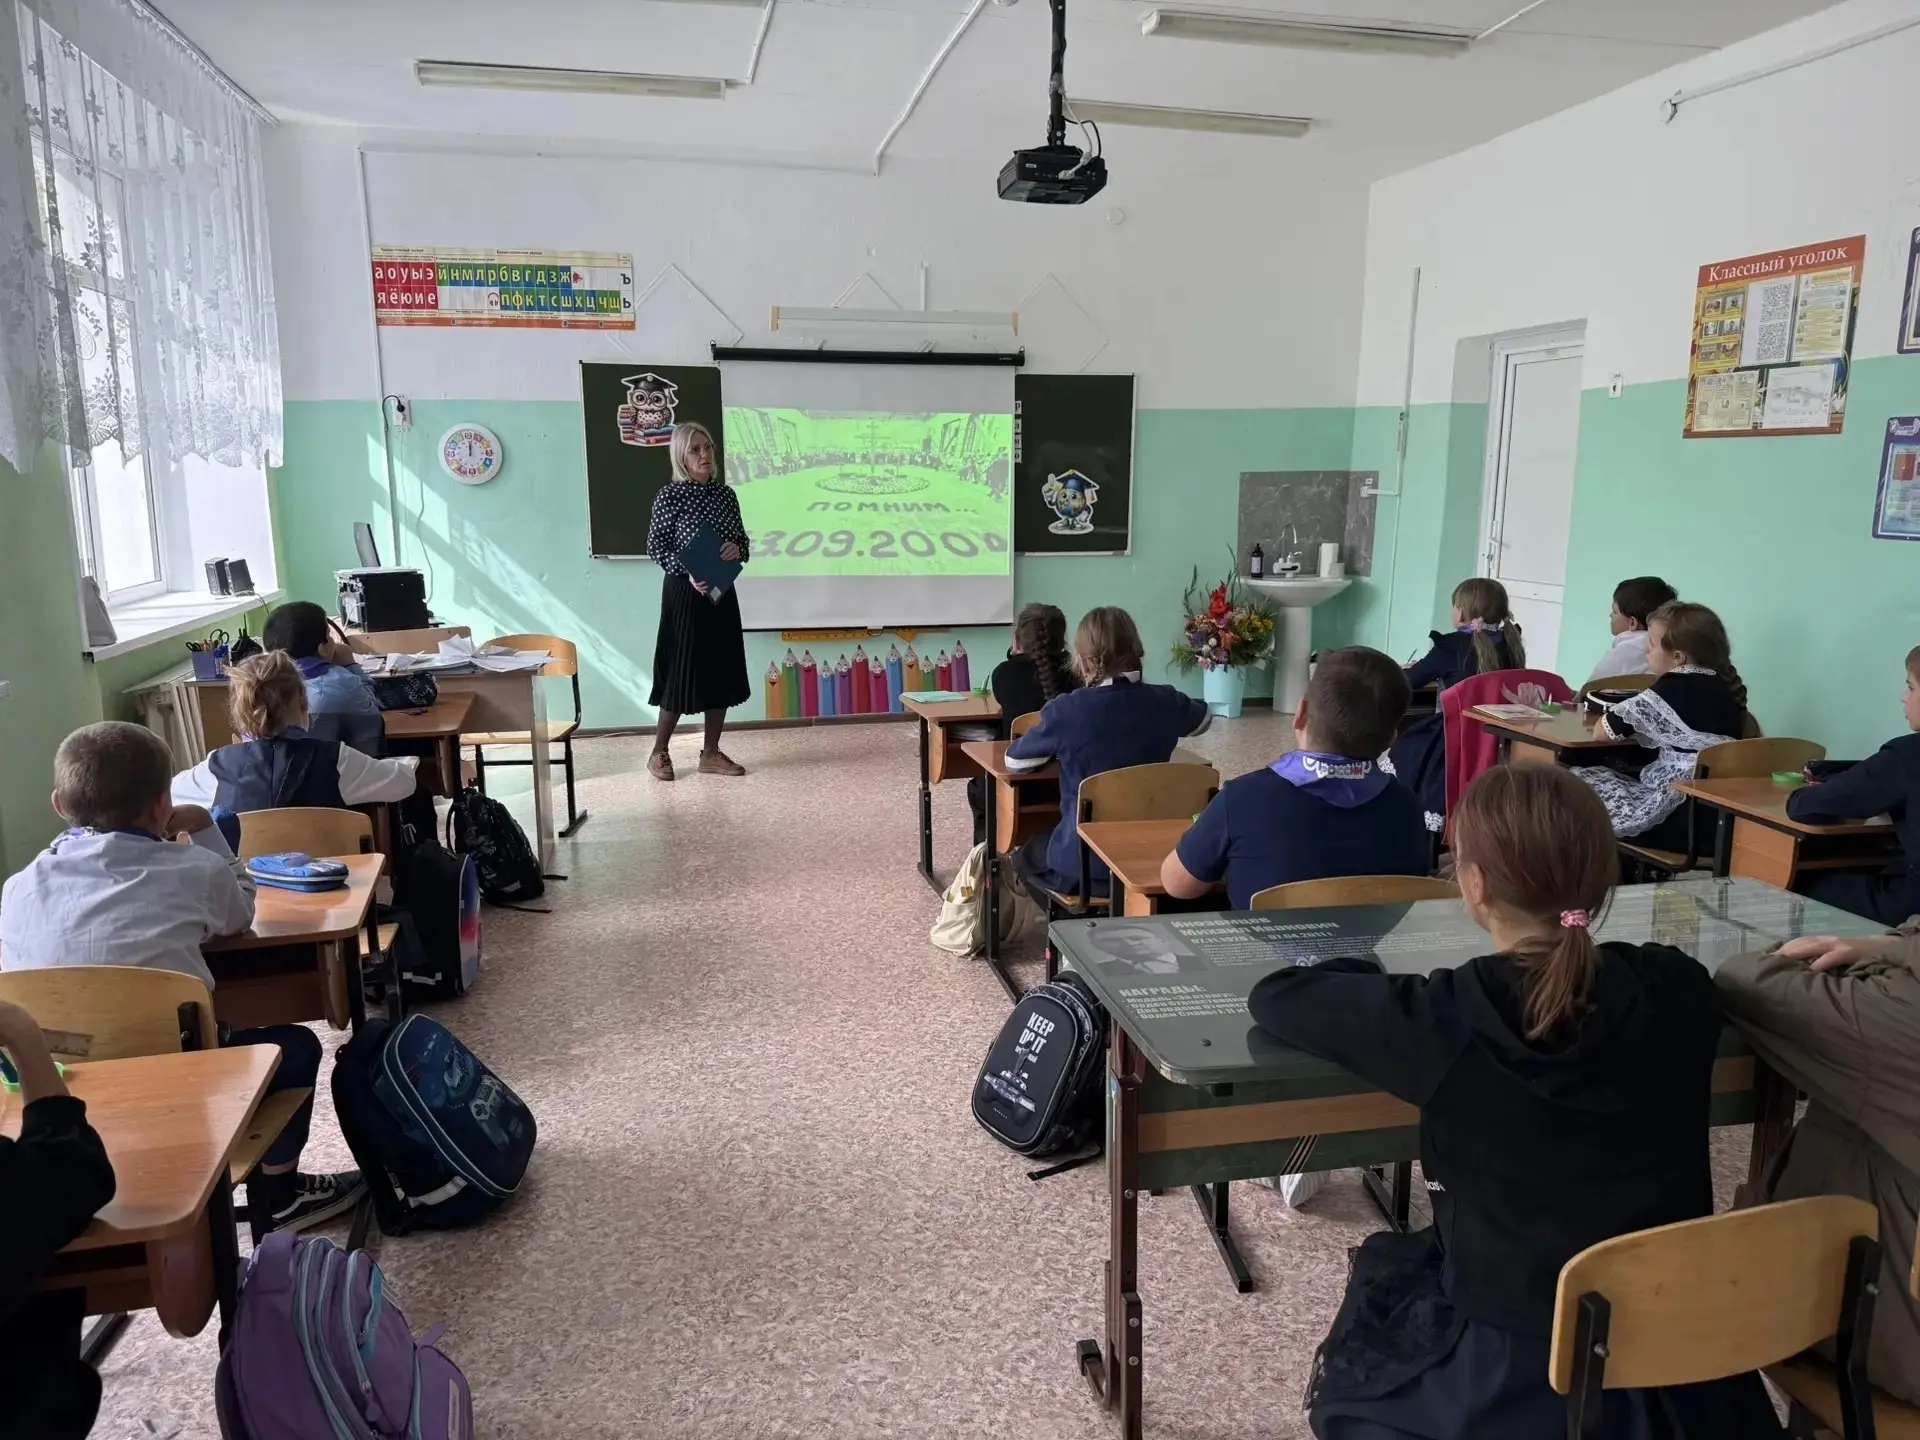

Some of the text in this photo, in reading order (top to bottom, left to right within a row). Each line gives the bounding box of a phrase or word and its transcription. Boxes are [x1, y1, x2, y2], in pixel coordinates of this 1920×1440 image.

[1708, 246, 1849, 282] Классный уголок
[1179, 922, 1340, 936] Михаил Иванович
[1027, 1012, 1056, 1037] KEEP
[1031, 1035, 1048, 1054] IT
